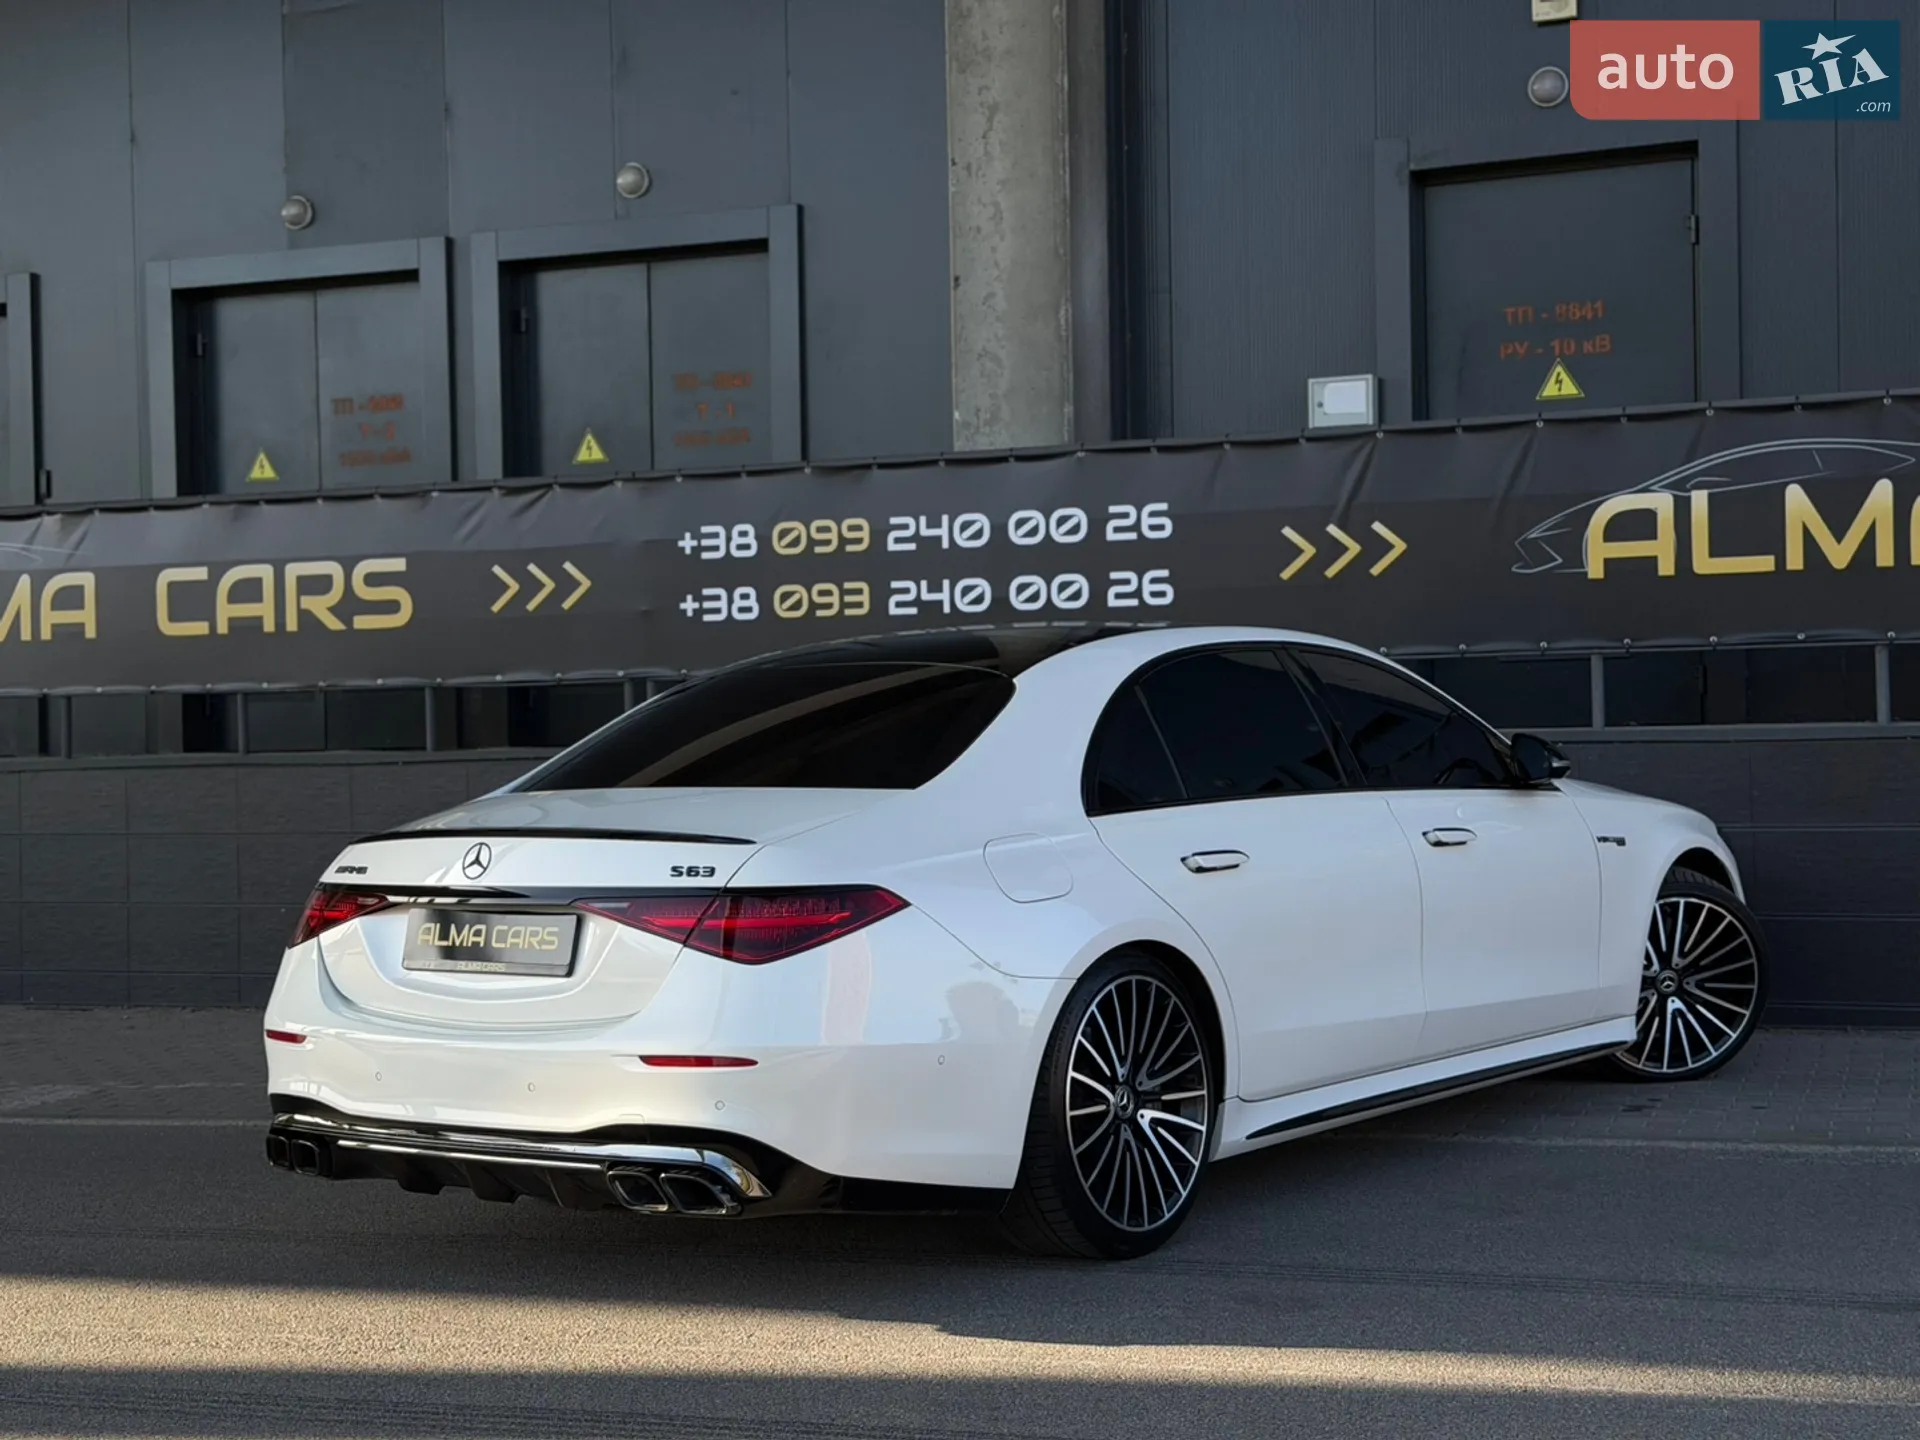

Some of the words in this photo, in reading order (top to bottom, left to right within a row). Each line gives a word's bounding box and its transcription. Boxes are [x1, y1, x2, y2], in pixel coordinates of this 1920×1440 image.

[1550, 338, 1576, 356] 10
[678, 524, 757, 559] +38
[772, 518, 870, 555] 099
[887, 513, 991, 551] 240
[1008, 507, 1088, 545] 00
[1106, 503, 1173, 541] 26
[1587, 478, 1920, 579] ALM
[156, 557, 413, 636] CARS
[680, 587, 759, 622] +38
[773, 582, 870, 618] 093
[888, 578, 992, 616] 240
[1009, 574, 1089, 611] 00
[1107, 569, 1175, 608] 26
[669, 865, 716, 878] S63
[417, 922, 487, 948] ALMA
[491, 925, 560, 950] CARS
